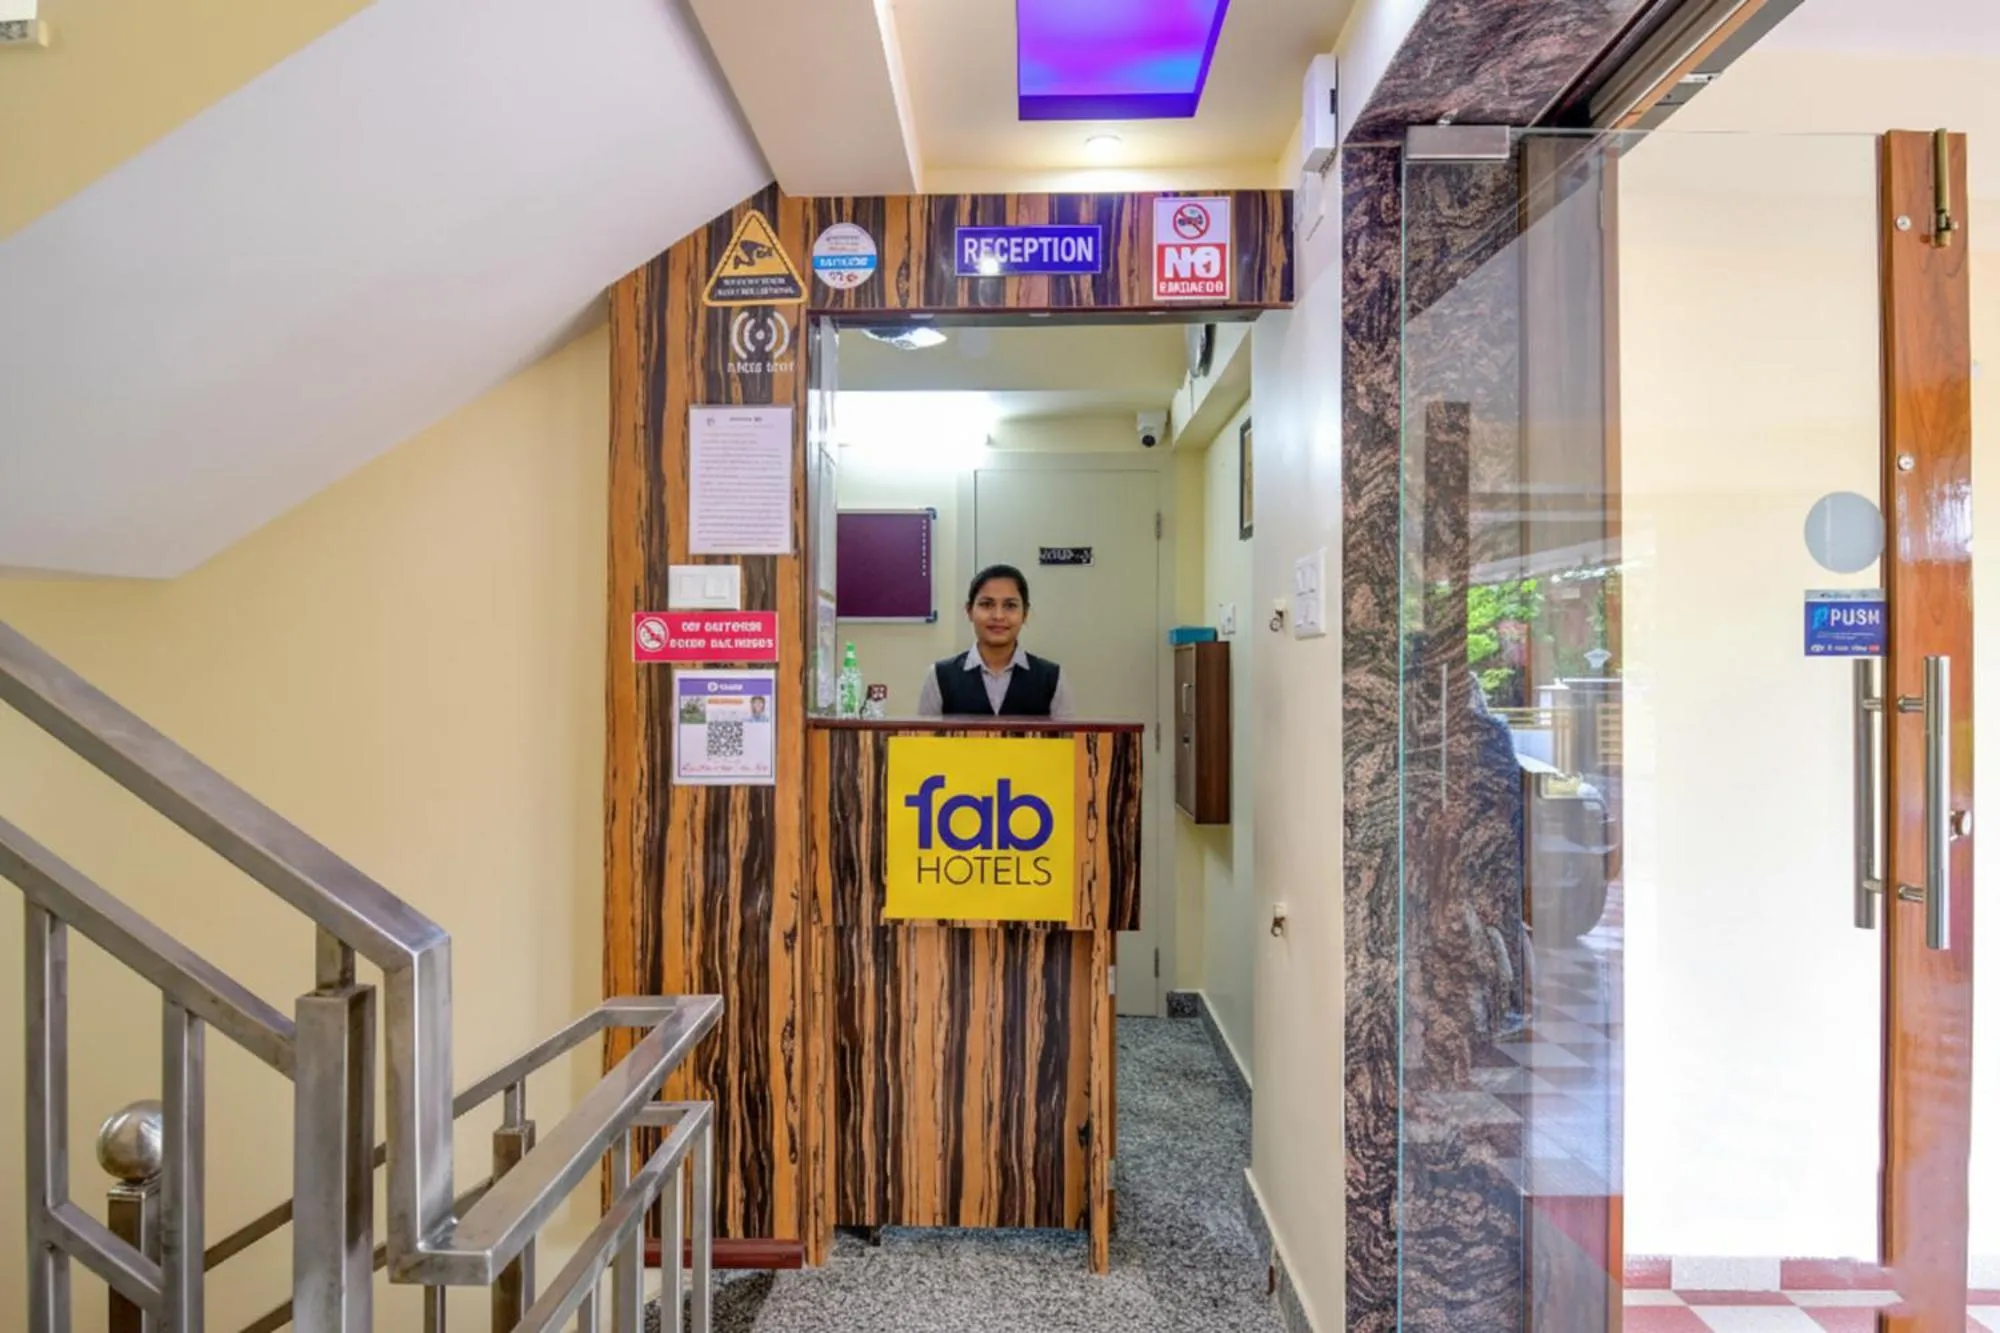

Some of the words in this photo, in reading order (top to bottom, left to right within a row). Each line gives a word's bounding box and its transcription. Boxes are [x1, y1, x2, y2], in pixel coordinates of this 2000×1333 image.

[964, 236, 1093, 263] RECEPTION
[1164, 246, 1221, 278] NO
[1830, 608, 1880, 626] PUSH
[904, 775, 1054, 851] fab
[917, 855, 1052, 885] HOTELS
